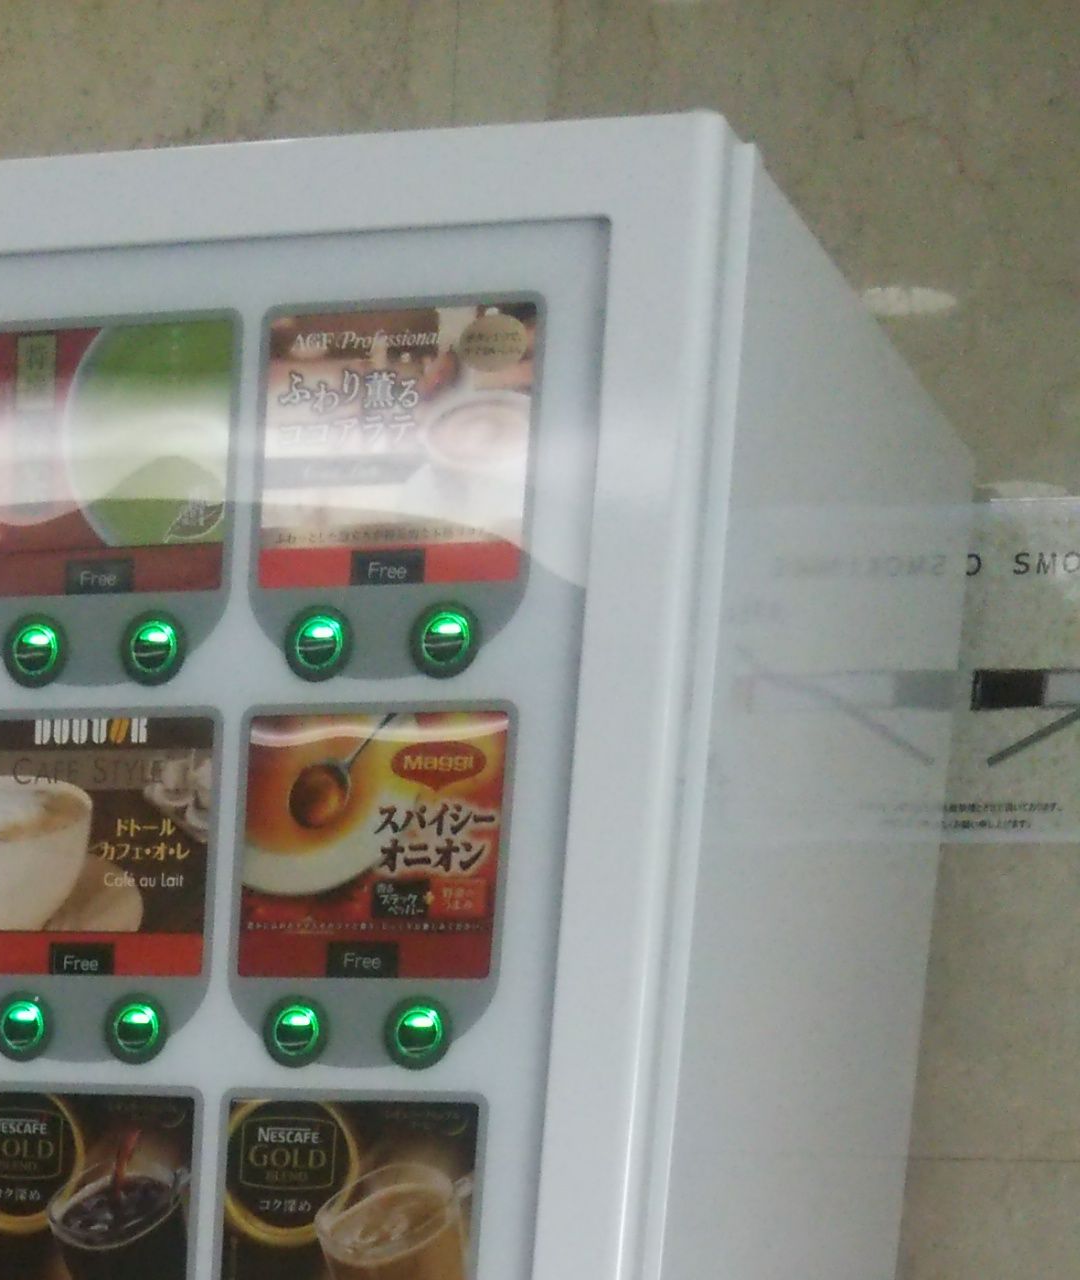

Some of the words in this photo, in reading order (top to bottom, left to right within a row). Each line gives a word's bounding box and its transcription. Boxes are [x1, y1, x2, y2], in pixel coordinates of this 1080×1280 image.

[293, 332, 334, 352] AGF
[335, 330, 442, 357] Professional
[278, 370, 419, 413] ふわり薫る
[80, 570, 117, 586] Free
[368, 561, 407, 580] Free
[403, 754, 474, 773] Maggi
[116, 818, 176, 837] ドトール
[374, 803, 496, 836] スパイシー
[99, 841, 190, 861] カフェ・オ・レ
[380, 838, 487, 873] オニオン
[103, 871, 136, 888] Café
[139, 874, 156, 888] au
[160, 873, 185, 888] Lait
[63, 955, 100, 972] Free
[344, 952, 382, 970] Free
[248, 1145, 328, 1169] GOLD
[259, 1199, 312, 1212] コク深め
